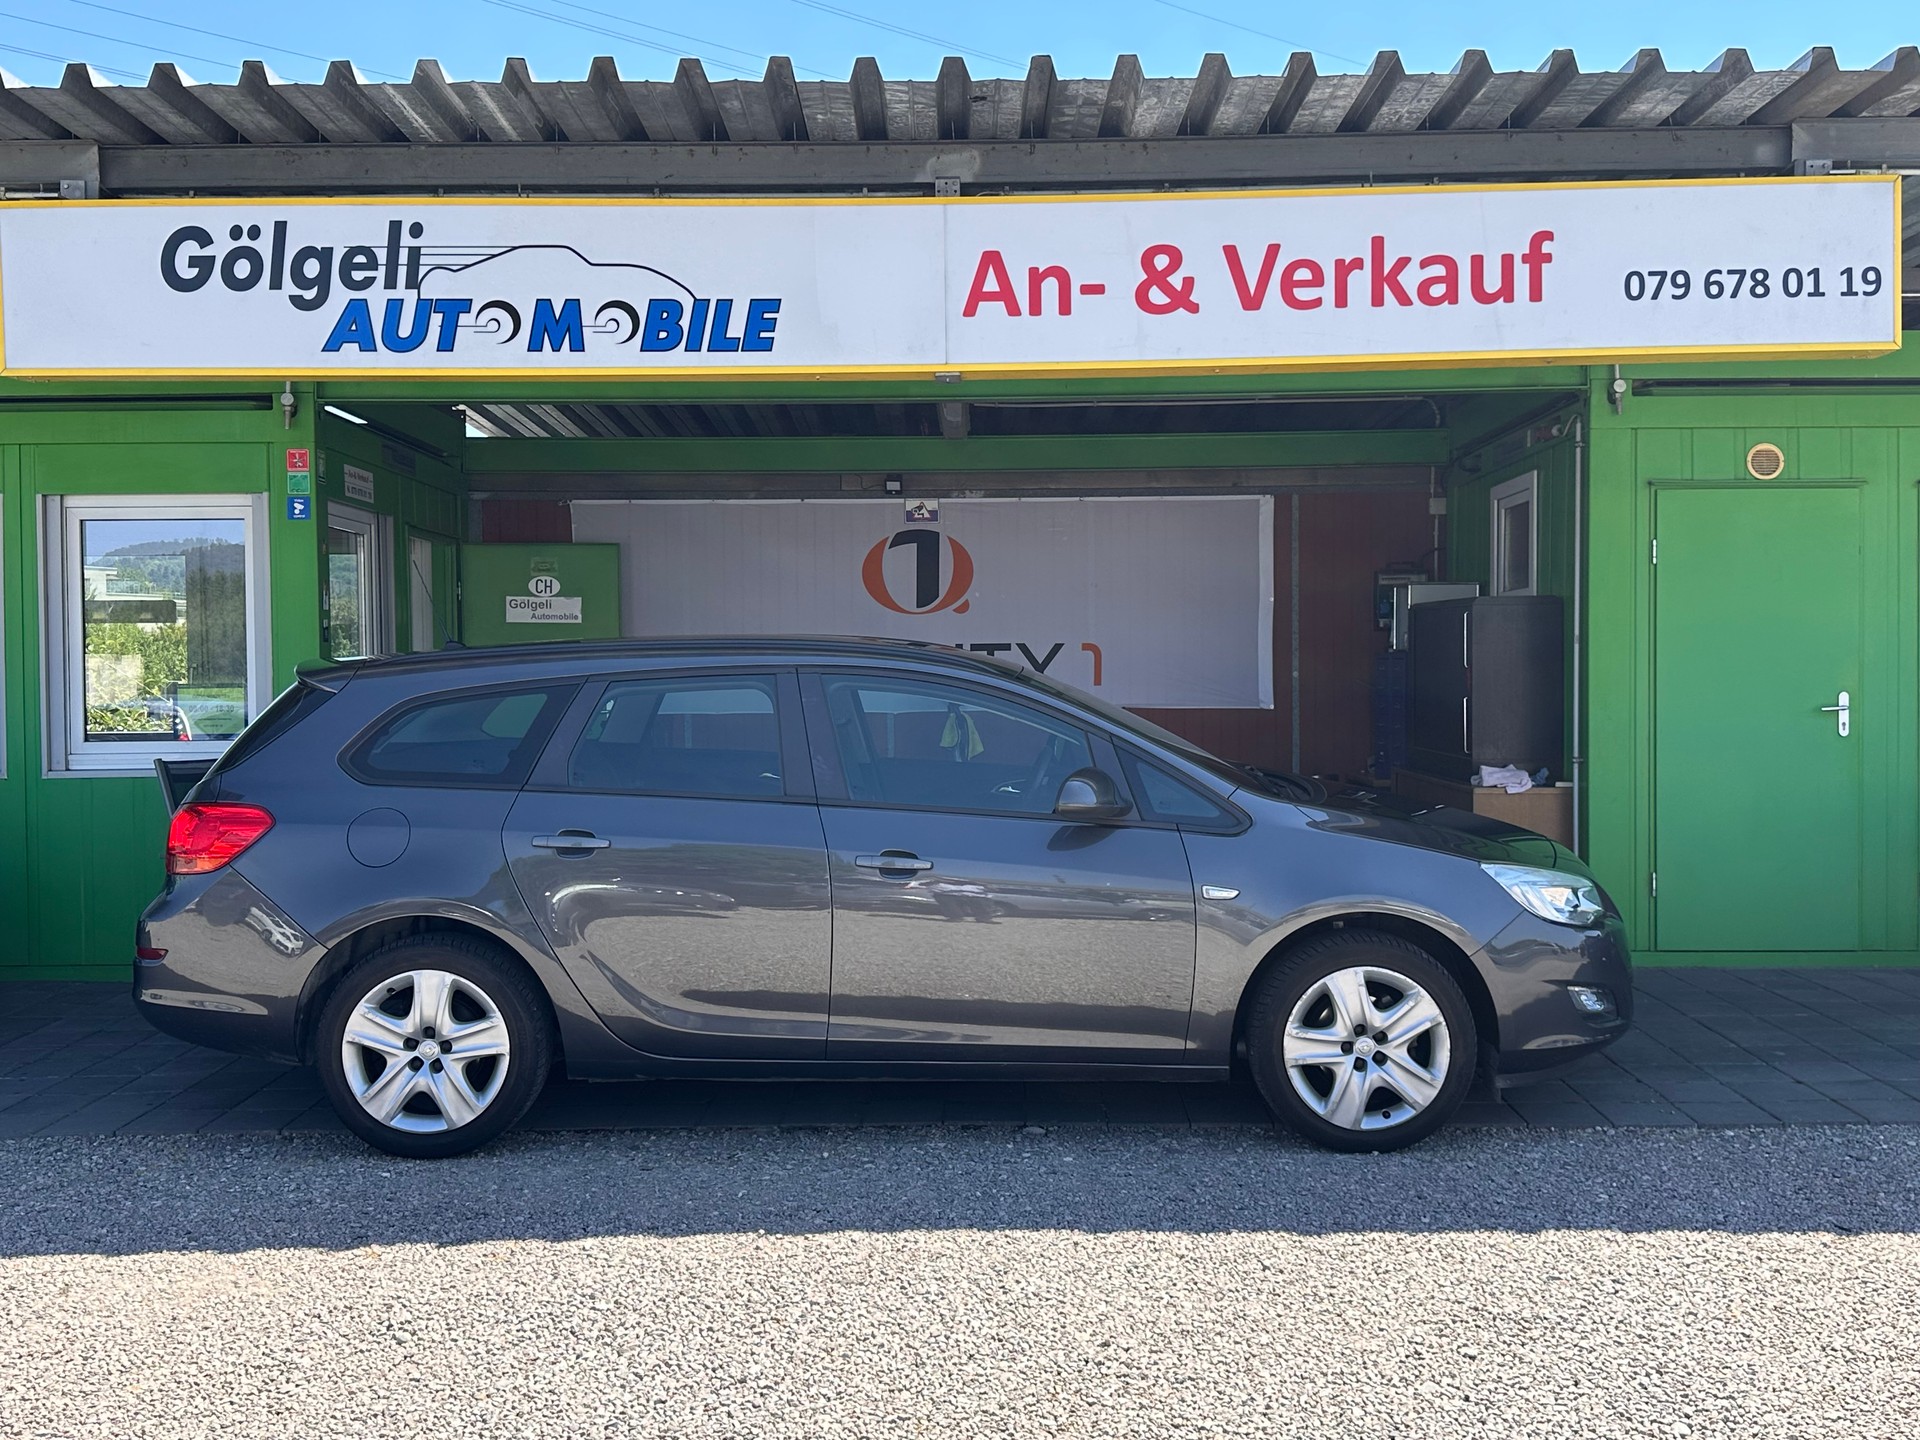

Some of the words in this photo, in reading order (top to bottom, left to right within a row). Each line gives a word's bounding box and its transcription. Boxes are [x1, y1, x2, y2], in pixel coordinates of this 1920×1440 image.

[160, 220, 424, 311] Gölgeli
[962, 250, 1106, 317] An-
[1134, 243, 1200, 315] &
[1221, 230, 1555, 311] Verkauf
[1624, 269, 1691, 301] 079
[1703, 268, 1771, 299] 678
[1782, 267, 1826, 298] 01
[1839, 266, 1882, 297] 19
[321, 298, 780, 353] AUTOMOBILE
[508, 598, 552, 612] Gölgeli
[535, 578, 553, 594] CH
[530, 612, 579, 620] Automobile
[1081, 643, 1102, 686] 1
